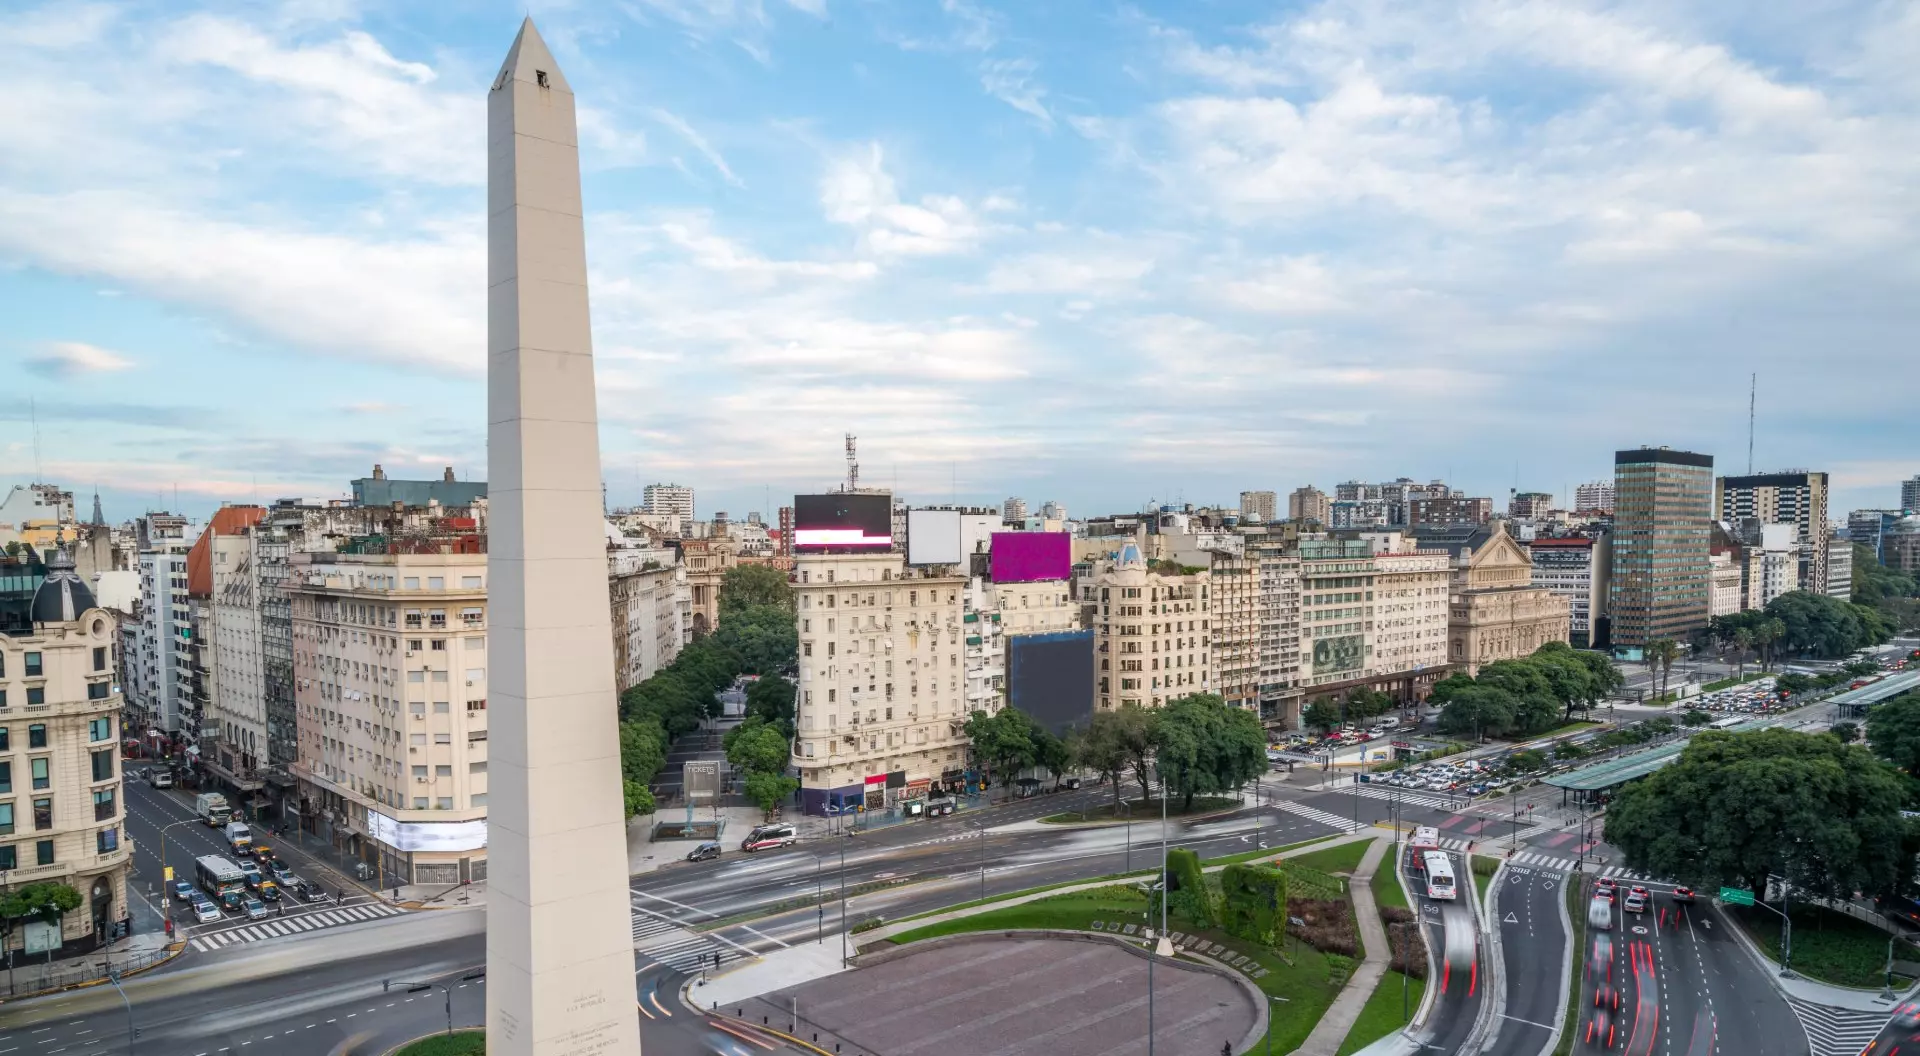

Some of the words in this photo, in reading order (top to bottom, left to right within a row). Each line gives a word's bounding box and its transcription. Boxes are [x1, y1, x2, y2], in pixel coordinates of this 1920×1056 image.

[1510, 866, 1531, 875] BUS
[1541, 871, 1562, 881] BUS
[1423, 904, 1439, 914] 59
